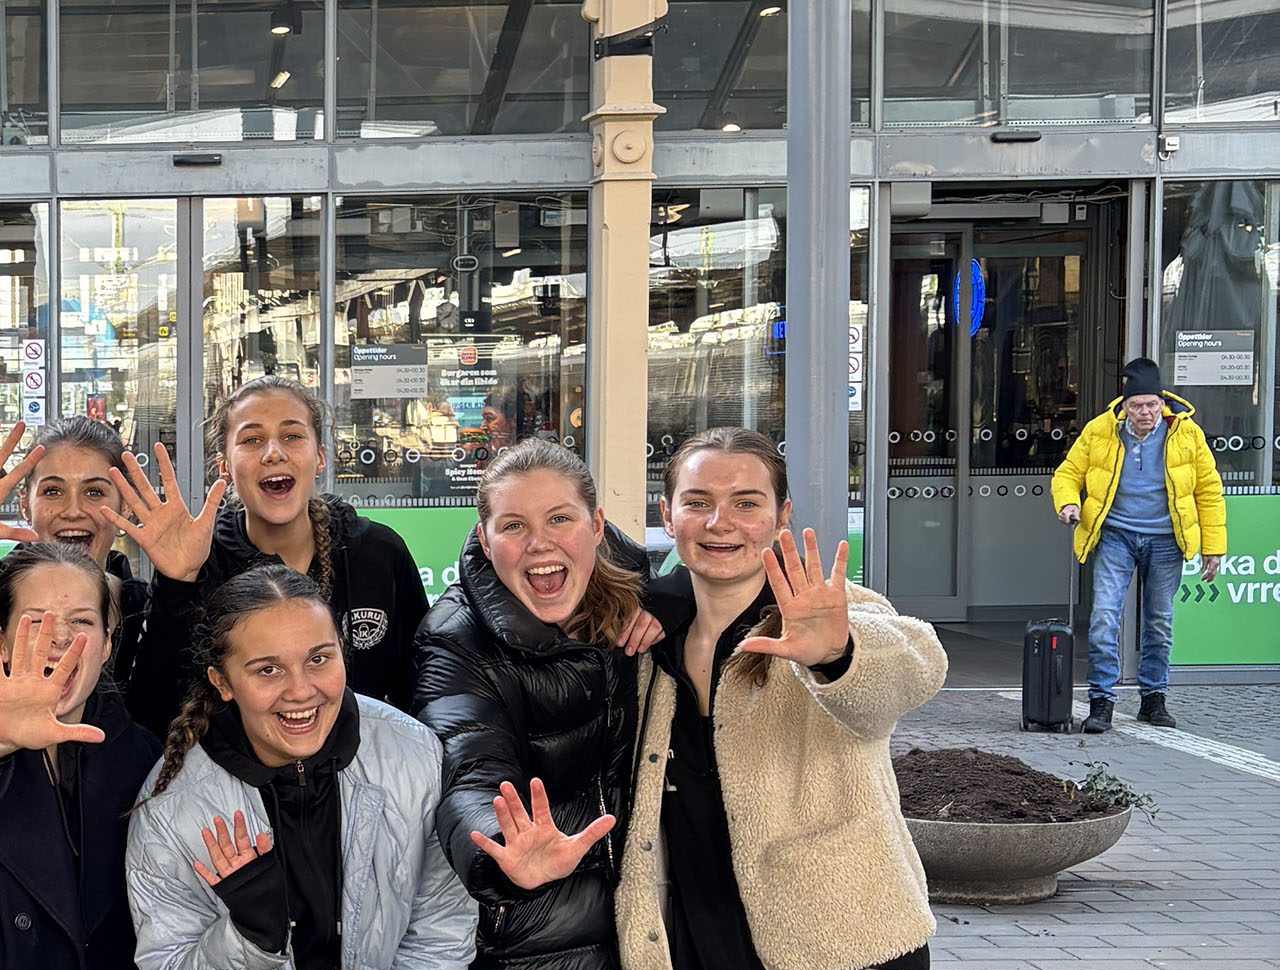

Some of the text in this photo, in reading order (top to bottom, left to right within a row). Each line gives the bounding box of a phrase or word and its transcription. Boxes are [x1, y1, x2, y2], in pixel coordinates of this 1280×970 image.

[1178, 333, 1212, 341] Öppettider
[353, 346, 387, 354] Öppettider
[1182, 553, 1255, 576] Bka
